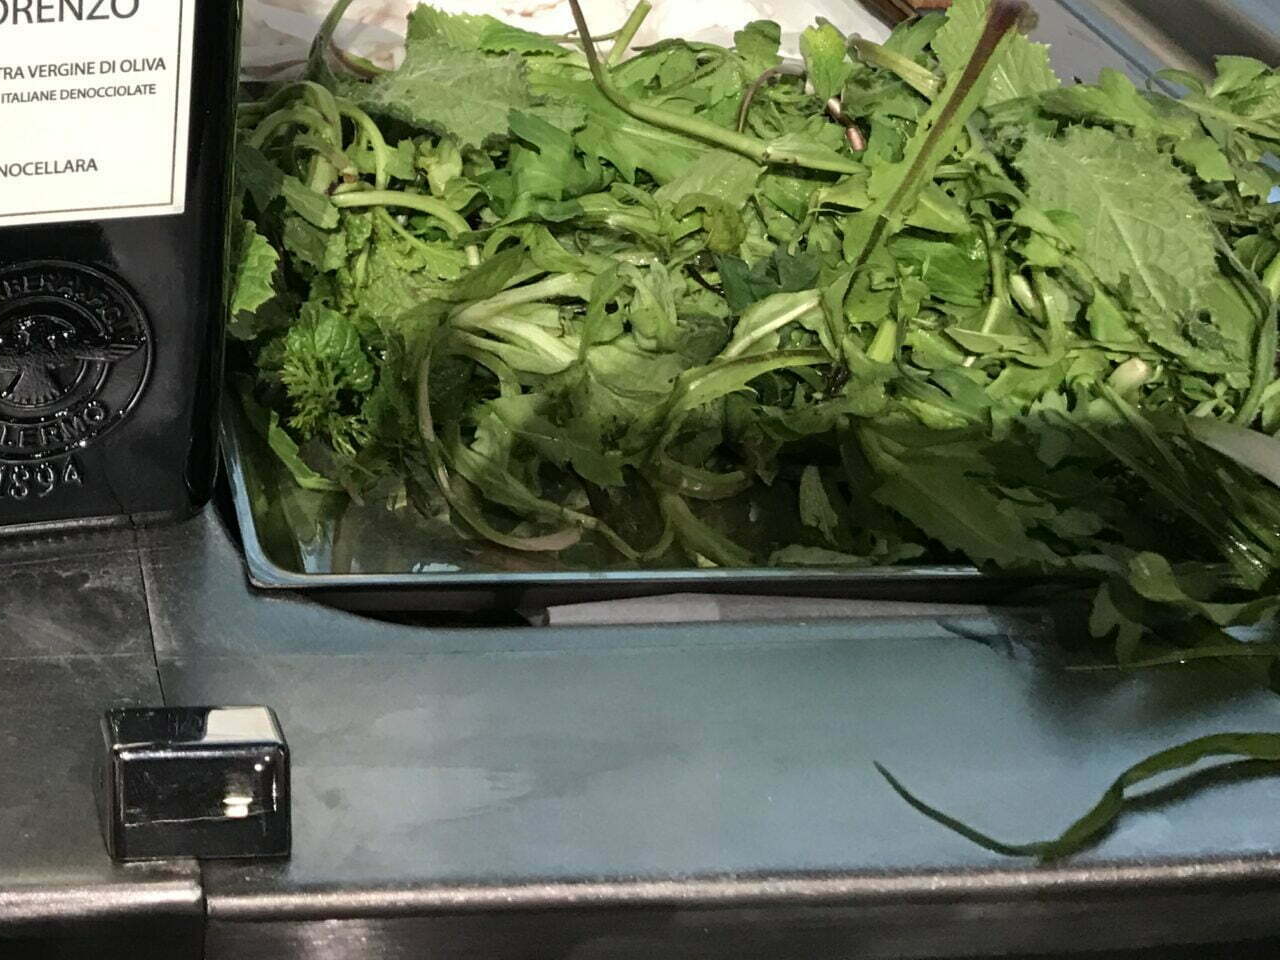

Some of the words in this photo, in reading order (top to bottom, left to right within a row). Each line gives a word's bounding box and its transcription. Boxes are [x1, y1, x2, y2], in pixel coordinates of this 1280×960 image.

[27, 62, 96, 80] VERGINE
[99, 60, 117, 75] DI
[119, 57, 166, 73] OLIVA
[0, 90, 57, 105] ITALIANE
[59, 83, 157, 101] DENOCCIOLATE
